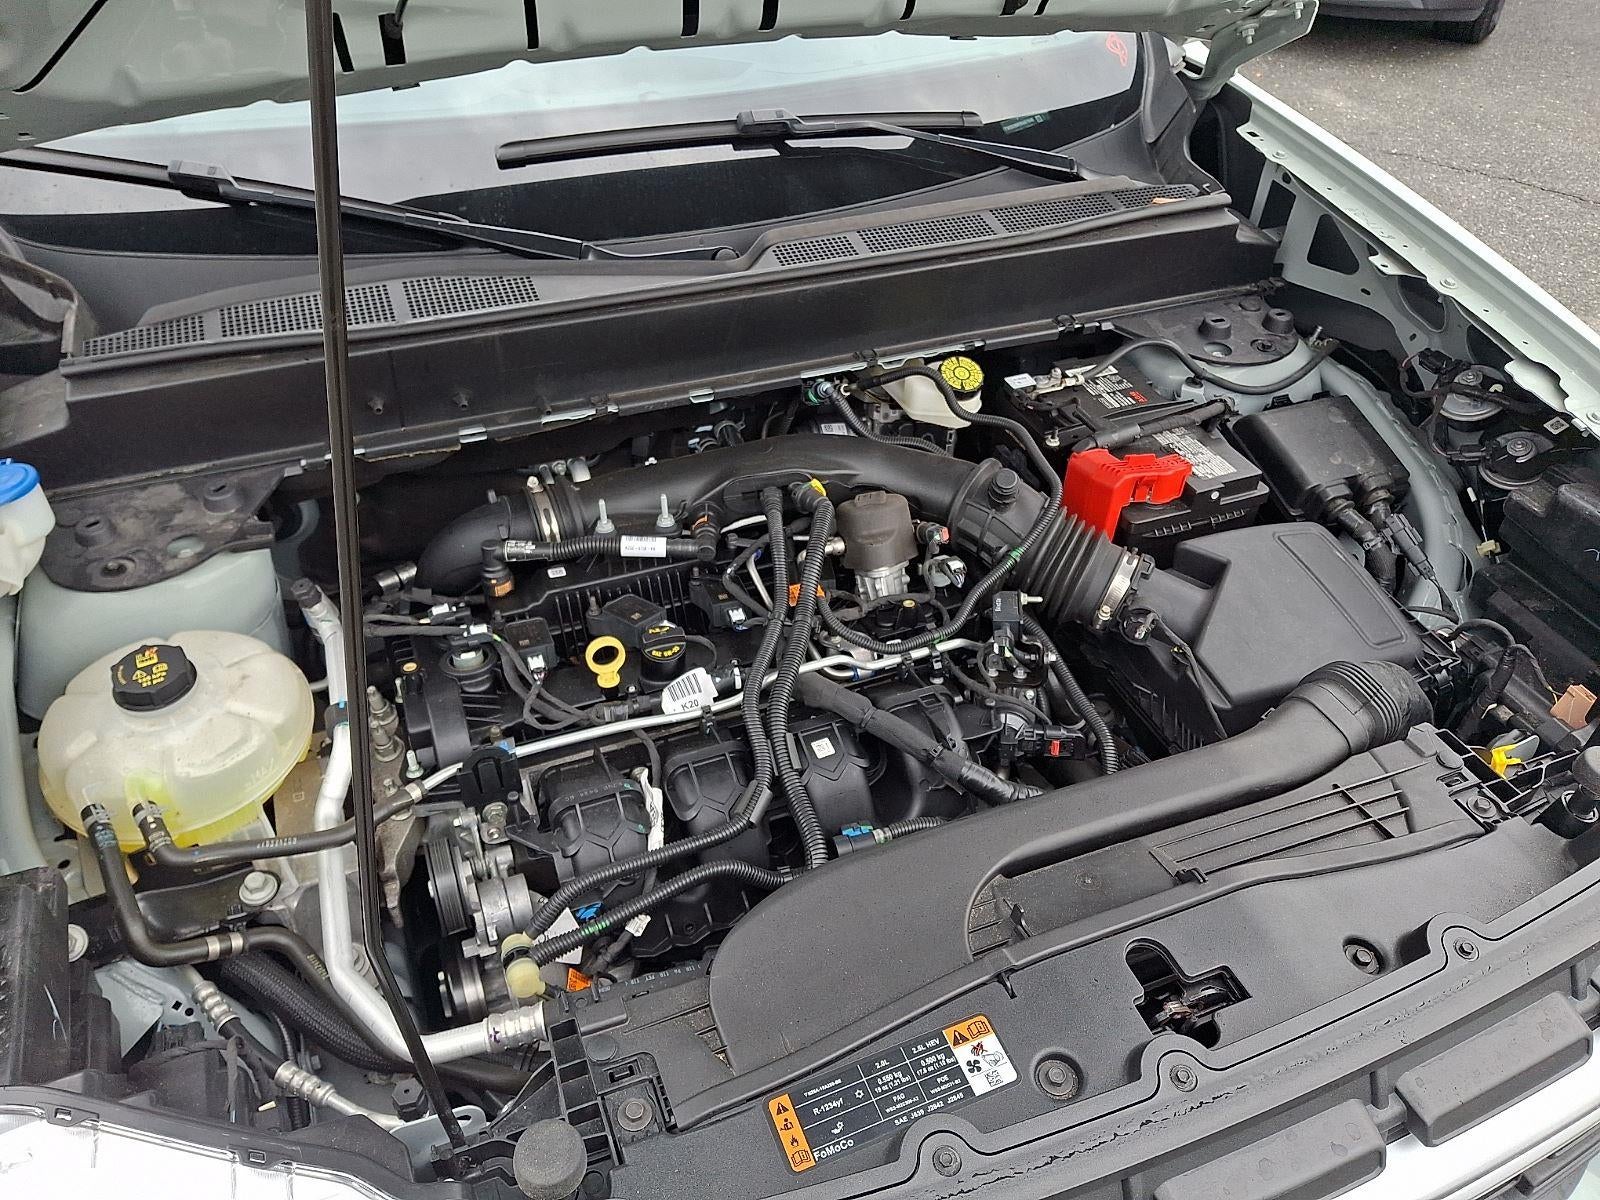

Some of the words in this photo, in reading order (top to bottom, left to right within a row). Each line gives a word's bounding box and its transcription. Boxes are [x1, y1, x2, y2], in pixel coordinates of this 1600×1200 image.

[681, 698, 699, 711] K20
[911, 1044, 926, 1054] 2.5L
[925, 1037, 941, 1049] HEV
[935, 1053, 945, 1061] kg
[874, 1059, 890, 1069] 2.0L
[892, 1070, 903, 1079] kg
[813, 1097, 844, 1116] R-1234yf
[894, 1115, 908, 1126] SAE
[813, 1139, 854, 1161] FoMoCo
